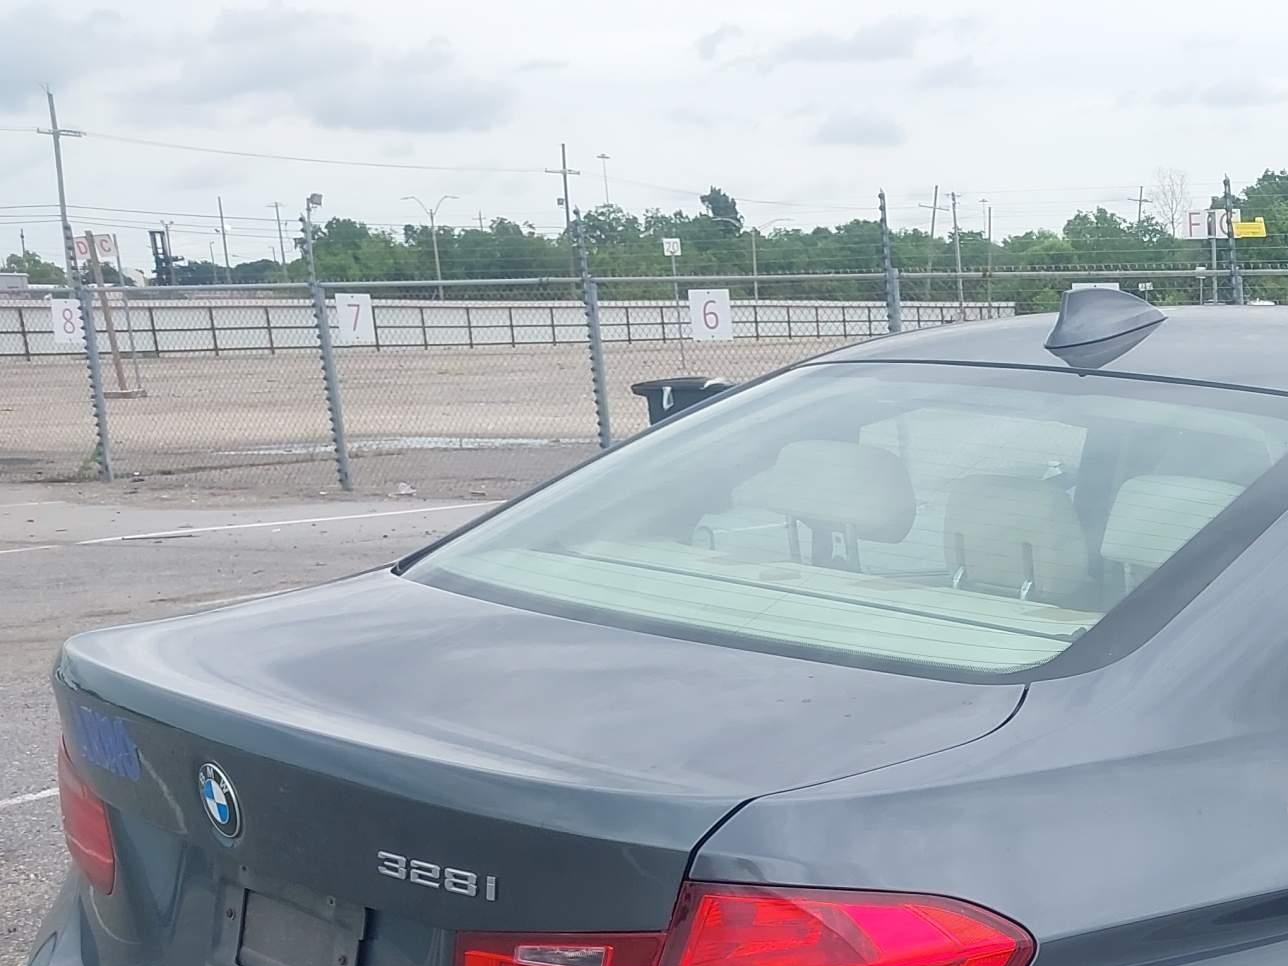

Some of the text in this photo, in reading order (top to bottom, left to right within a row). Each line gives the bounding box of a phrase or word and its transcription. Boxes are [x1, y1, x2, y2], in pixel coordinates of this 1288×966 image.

[1188, 212, 1201, 237] F
[75, 239, 112, 255] D C
[63, 308, 75, 334] 8
[347, 304, 360, 331] 7
[703, 300, 719, 330] 6
